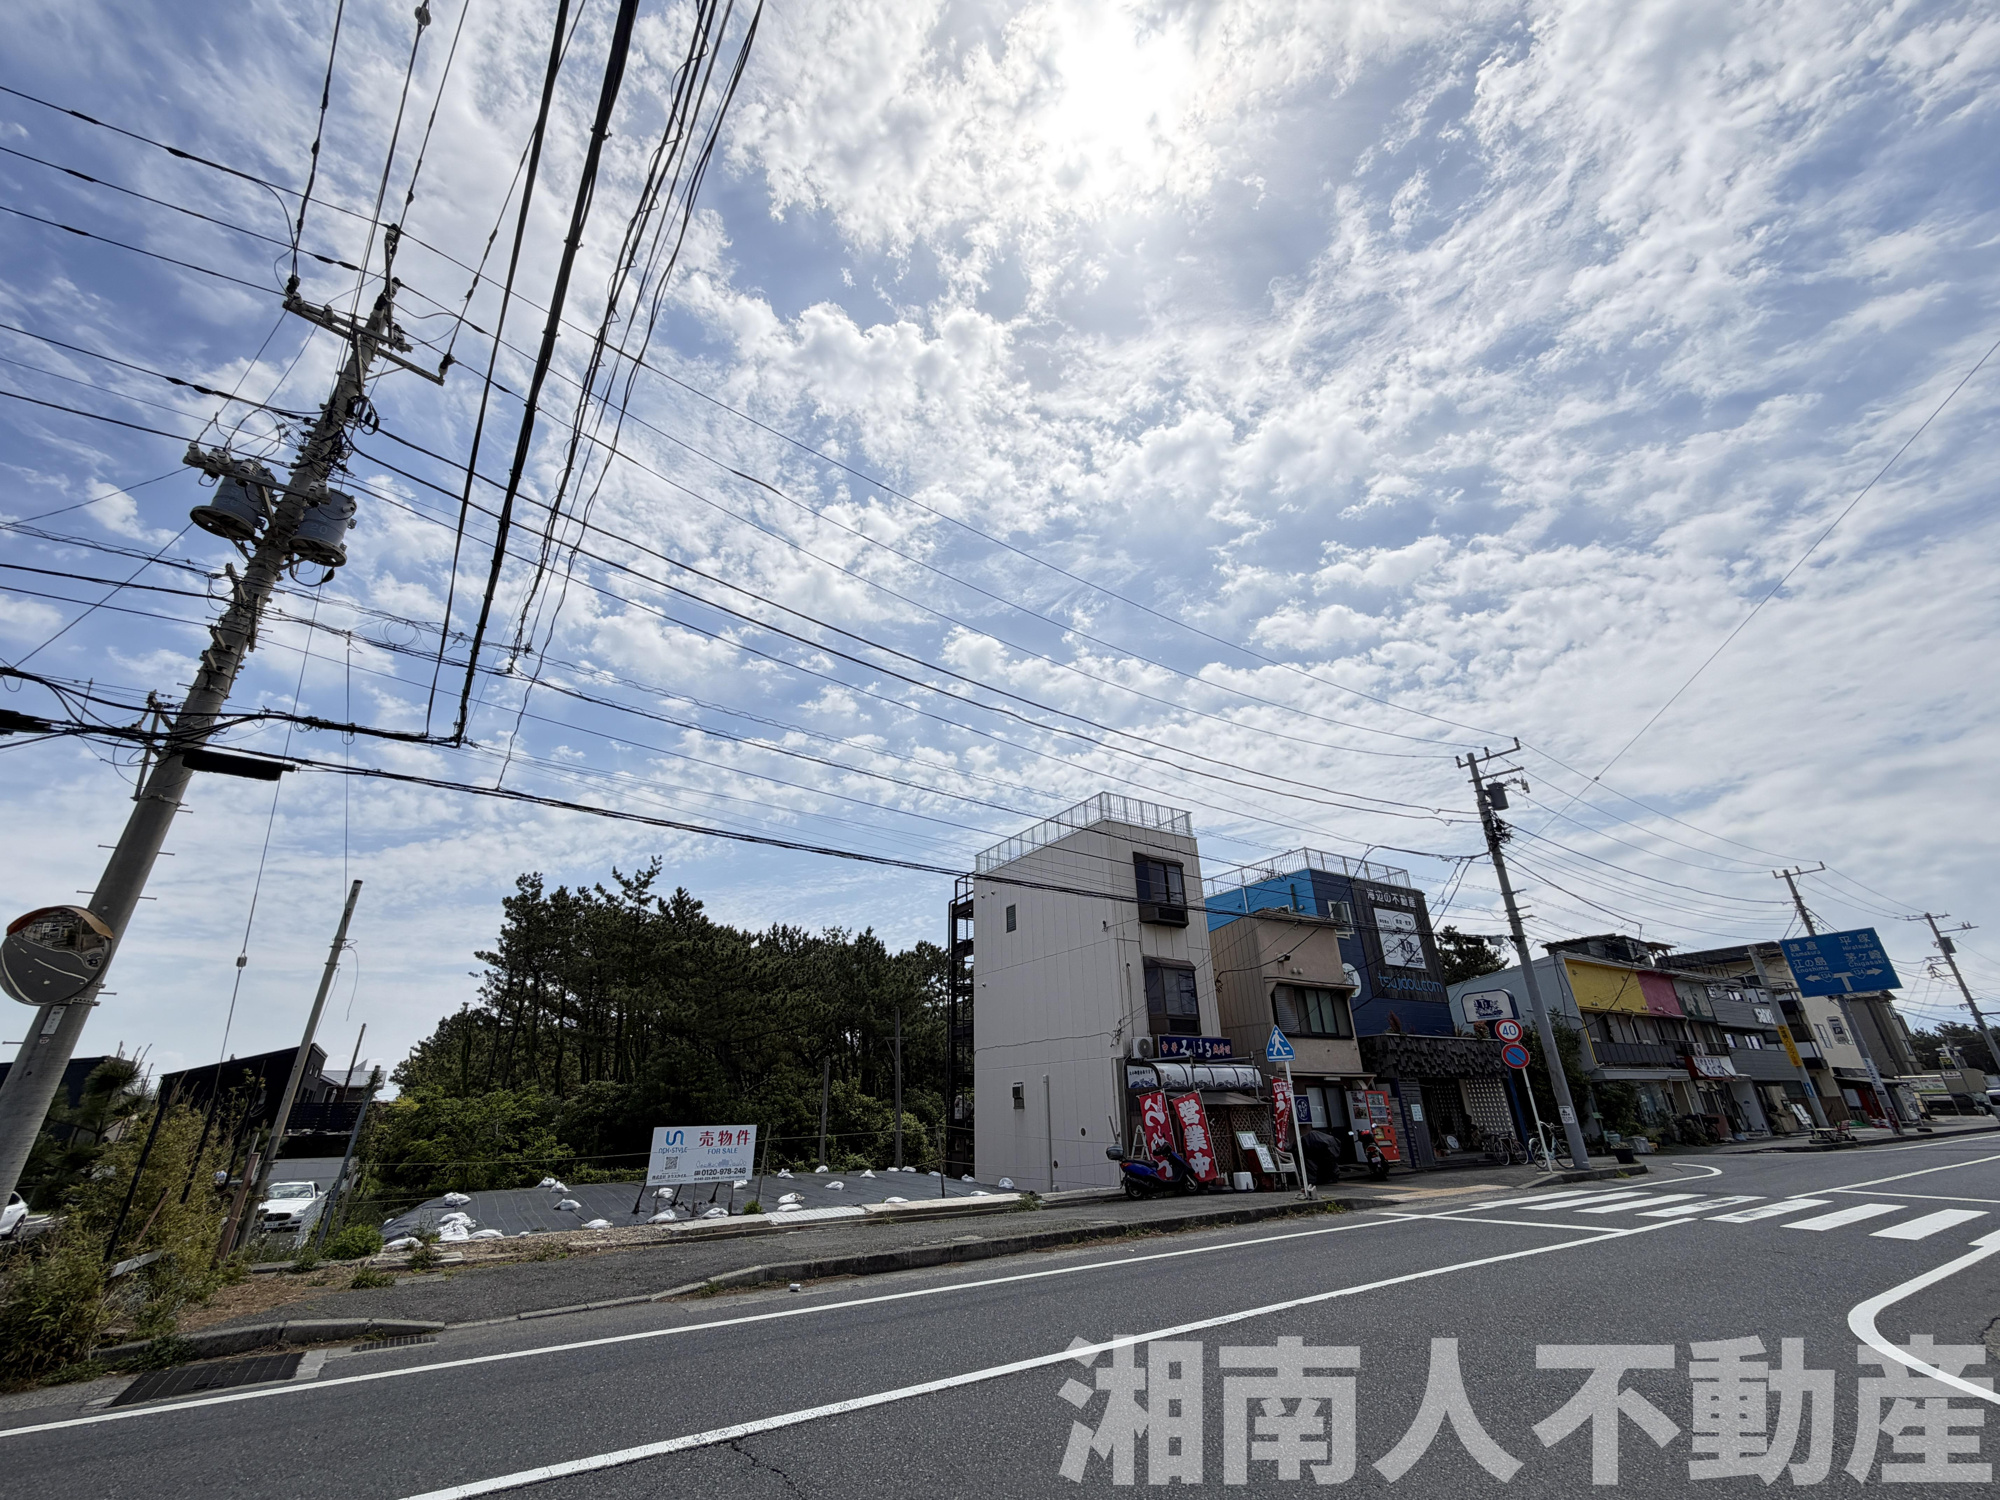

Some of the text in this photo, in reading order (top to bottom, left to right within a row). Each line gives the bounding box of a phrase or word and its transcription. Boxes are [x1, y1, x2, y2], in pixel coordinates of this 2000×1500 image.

[309, 524, 328, 535] 20
[1788, 933, 1871, 952] 鎌倉 平塚
[1841, 943, 1874, 951] Hiratsuka
[1792, 957, 1827, 969] 江の島
[1796, 958, 1885, 974] Enoshima Chigasaki
[1502, 1025, 1517, 1036] 40
[699, 1129, 751, 1147] 売物件
[722, 1147, 738, 1155] SALE
[701, 1167, 746, 1176] 0120-978-248
